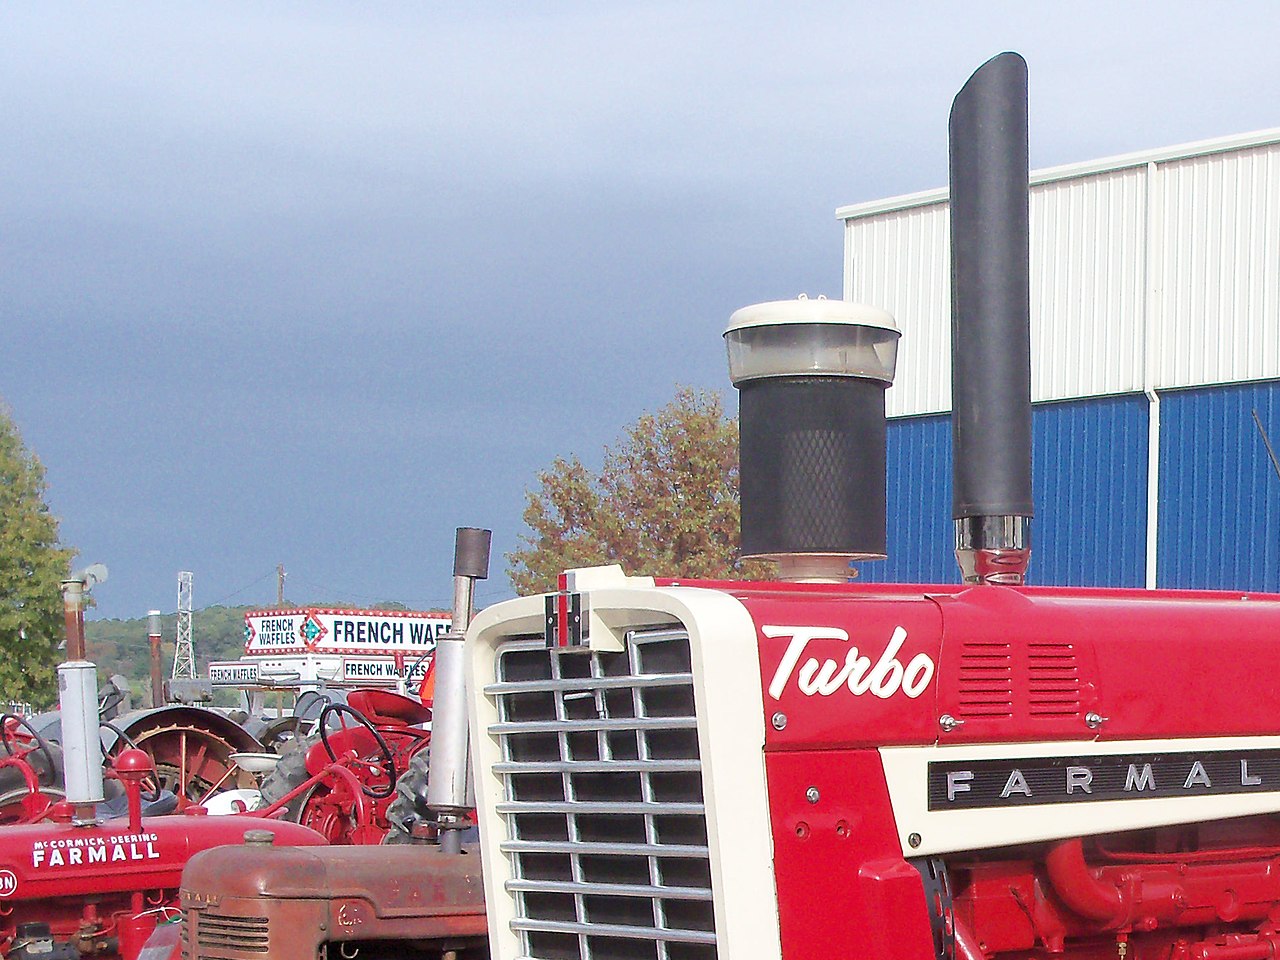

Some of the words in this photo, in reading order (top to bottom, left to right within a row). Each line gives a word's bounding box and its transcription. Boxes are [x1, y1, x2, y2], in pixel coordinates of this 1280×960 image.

[261, 618, 294, 632] FRENCH
[334, 620, 404, 644] FRENCH
[259, 632, 296, 645] WAFFLES
[345, 663, 383, 676] FRENCH
[761, 625, 935, 700] Turbo
[32, 841, 160, 868] FARMALL
